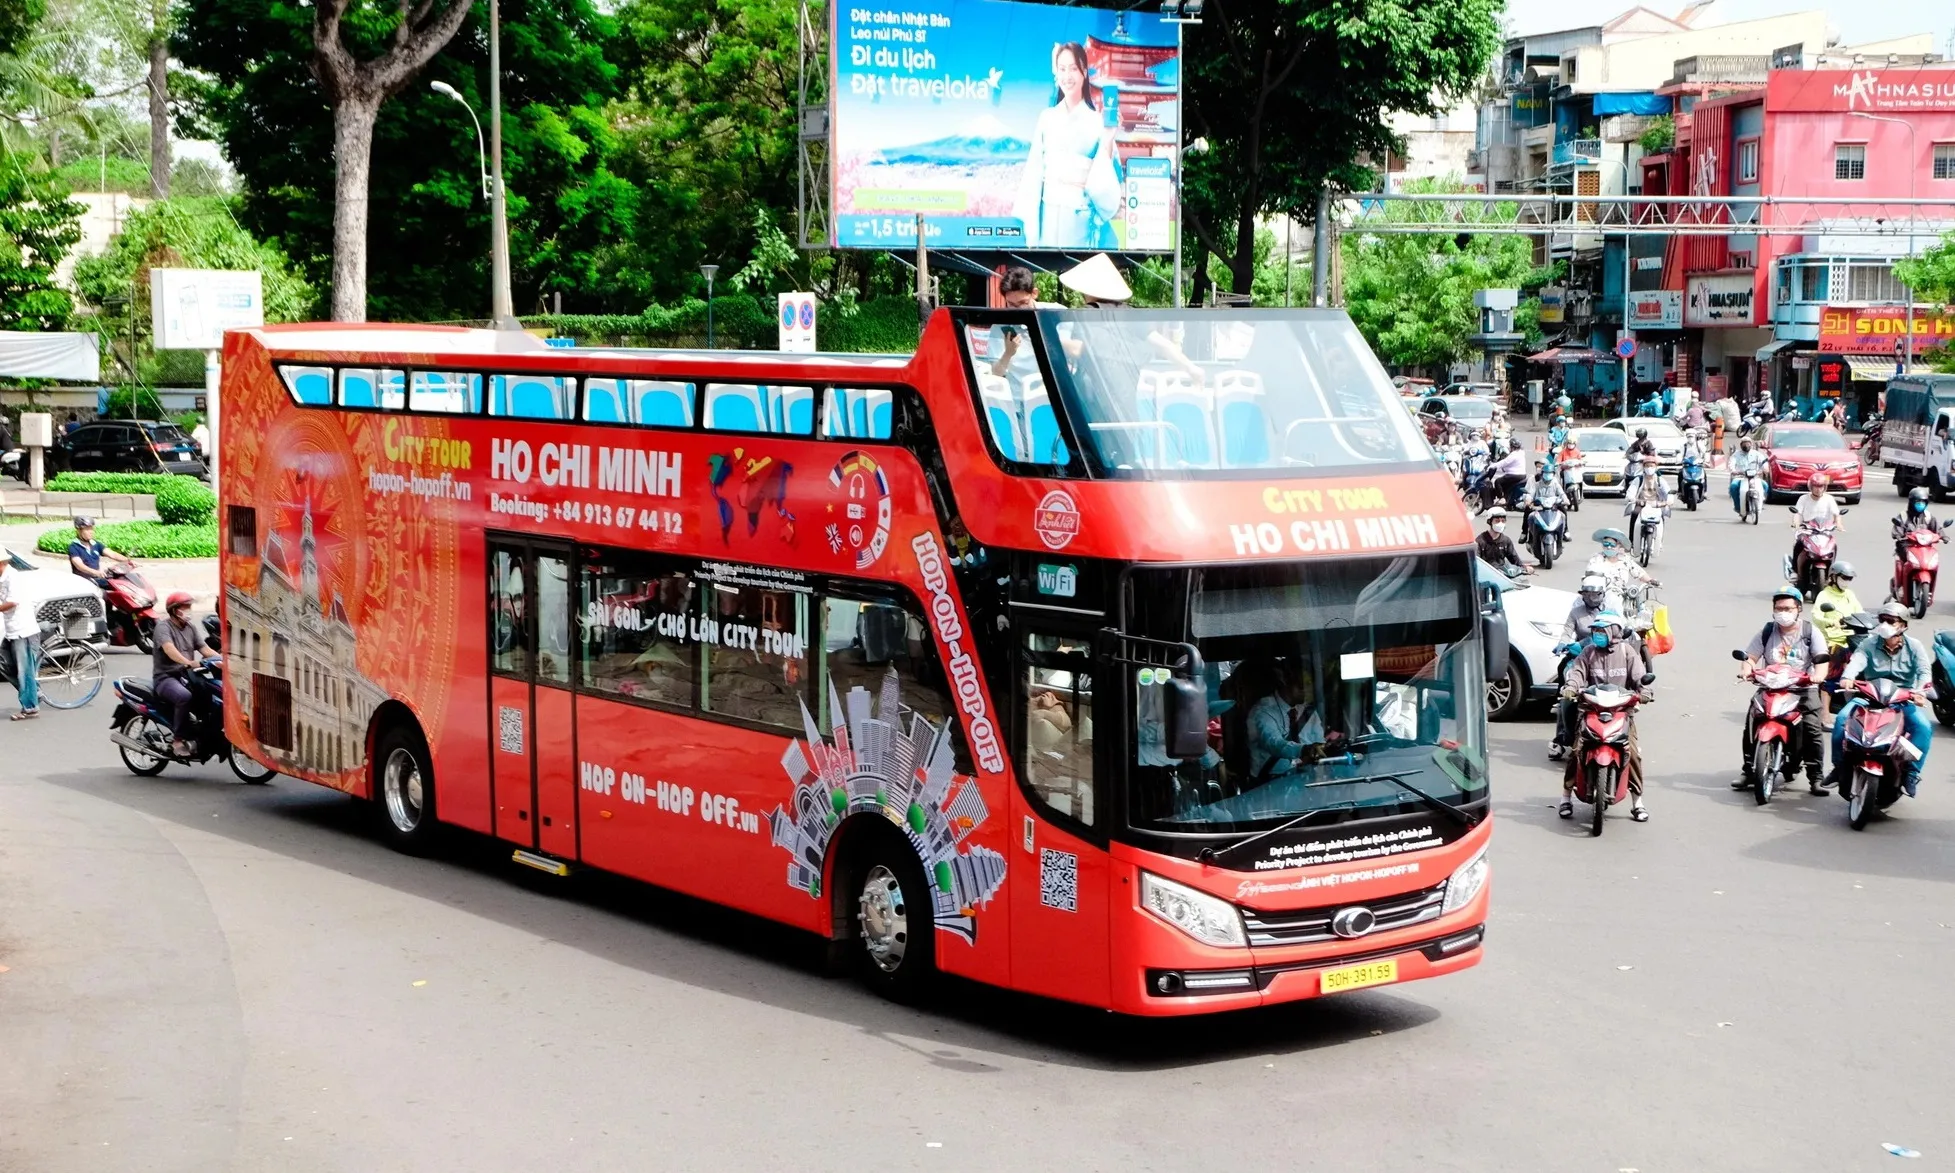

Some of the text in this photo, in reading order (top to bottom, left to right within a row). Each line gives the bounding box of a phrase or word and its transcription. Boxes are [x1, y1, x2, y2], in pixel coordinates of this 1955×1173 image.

[851, 8, 951, 28] Đặt chân Nhật Bản
[851, 26, 872, 40] Leo
[874, 27, 890, 41] núi
[892, 27, 913, 42] Phú
[851, 44, 936, 74] Đi du lịch
[851, 72, 989, 99] Đặt traveloka
[1856, 318, 1928, 334] SONG
[1822, 343, 1833, 351] 22
[384, 417, 472, 470] CITY TOUR
[369, 464, 472, 503] hopon-hopoff.vn
[491, 438, 682, 498] HO CHI MINH
[490, 492, 683, 535] Booking: +84 913 67 44 12
[1262, 486, 1389, 514] CITY TOUR
[1228, 514, 1439, 555] HO CHI MINH
[613, 601, 641, 632] GÒN
[657, 612, 687, 644] CHỢ
[689, 612, 719, 645] LỚN
[723, 623, 758, 652] CITY
[761, 628, 804, 659] TOUR
[578, 761, 759, 834] HOP ON-HOP OFF.VN
[1254, 837, 1443, 870] Priority Project to develop tourism by the Government
[1269, 847, 1283, 857] Dự
[1362, 836, 1372, 845] du
[1372, 833, 1386, 845] lịch
[1398, 828, 1419, 840] Chính
[1418, 826, 1433, 838] phủ
[1328, 964, 1390, 988] 50H-391.59
